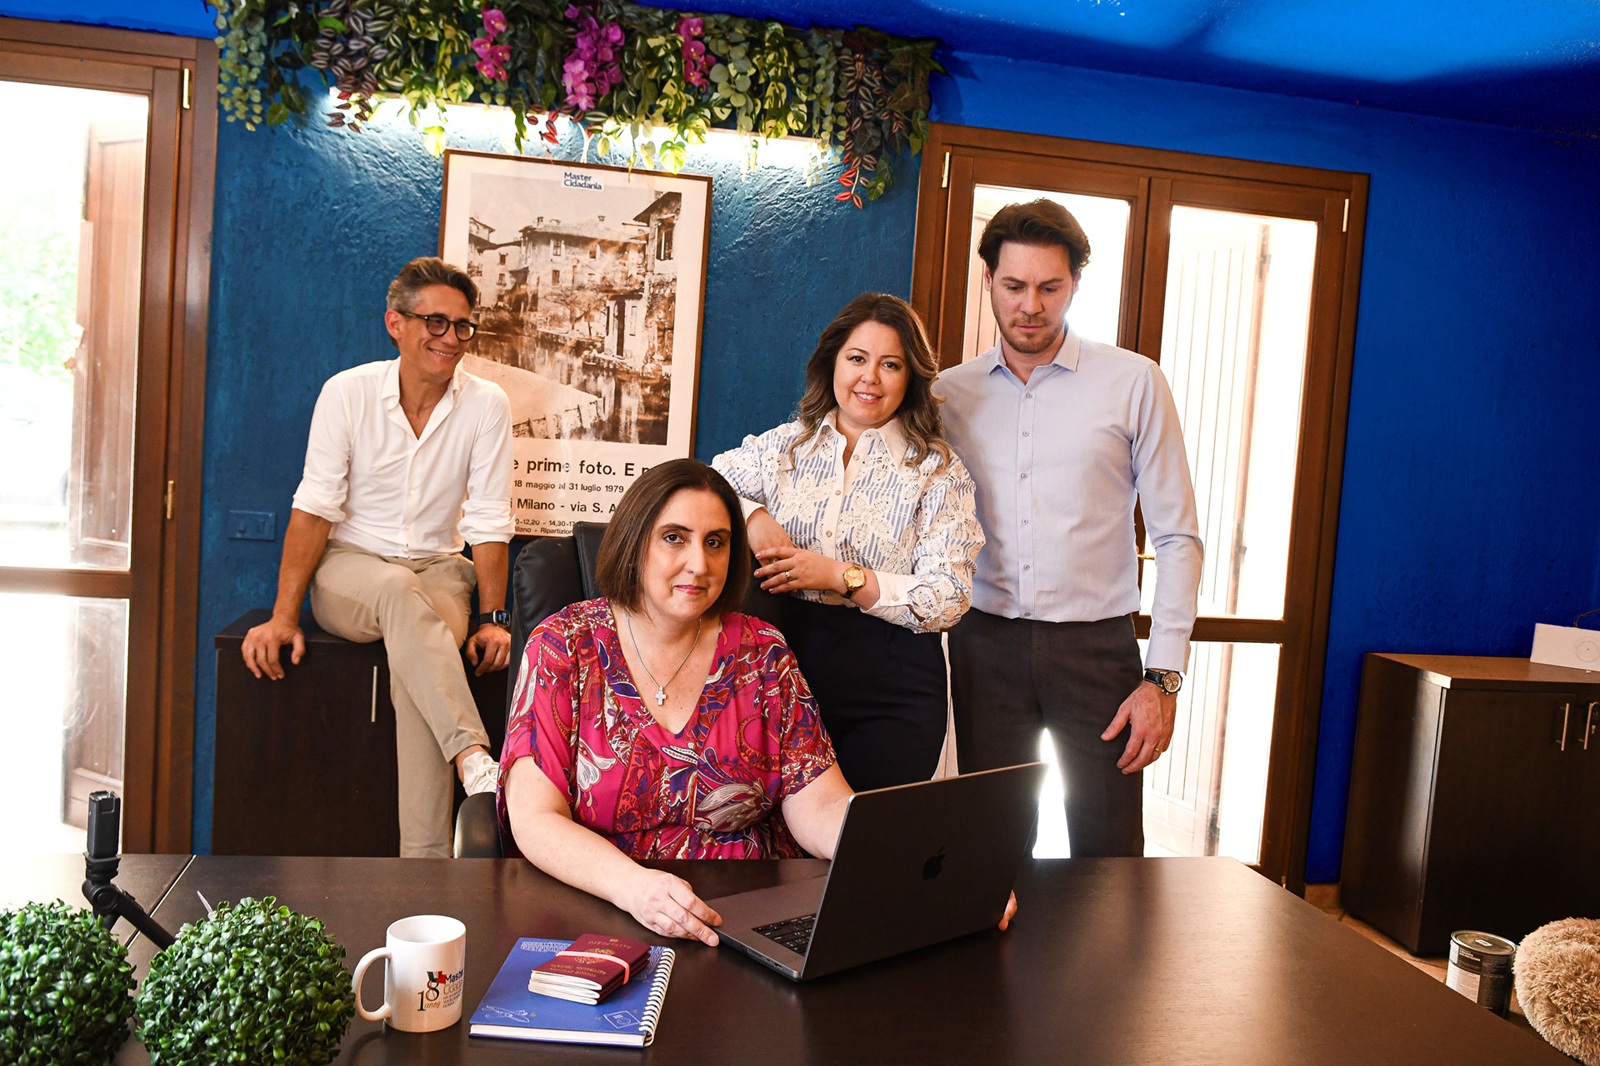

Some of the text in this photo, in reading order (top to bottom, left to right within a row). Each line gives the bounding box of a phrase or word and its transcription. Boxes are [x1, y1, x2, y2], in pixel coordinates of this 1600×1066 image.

[564, 172, 592, 181] Master
[564, 179, 602, 190] Cidadania
[527, 457, 570, 474] prime
[579, 459, 616, 476] foto.
[624, 462, 635, 476] E
[514, 480, 523, 488] 18
[525, 482, 556, 490] maggio
[568, 483, 578, 491] 31
[580, 483, 602, 493] luglio
[604, 484, 625, 493] 1979
[517, 498, 555, 511] Milano
[570, 501, 587, 513] via
[592, 502, 604, 513] S.
